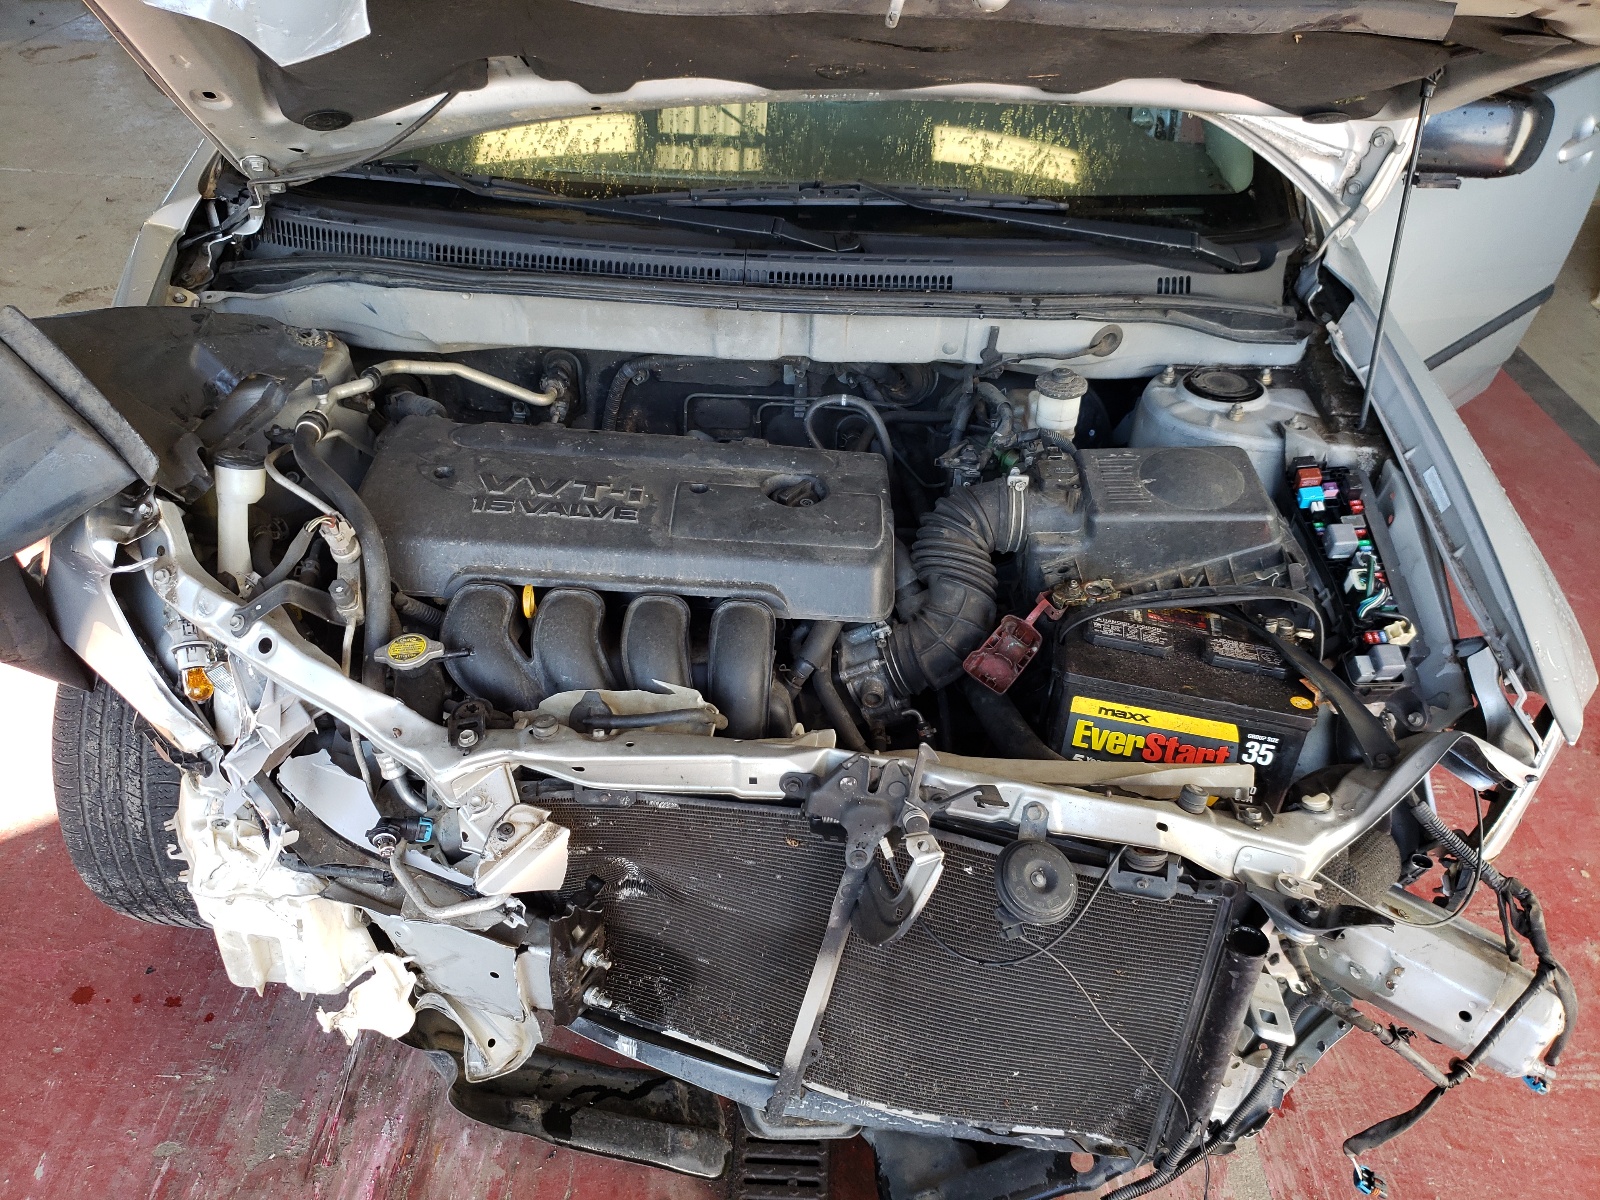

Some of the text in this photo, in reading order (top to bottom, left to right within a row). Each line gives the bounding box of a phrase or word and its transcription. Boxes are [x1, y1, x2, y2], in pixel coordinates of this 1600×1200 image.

[478, 473, 645, 506] VVT-i
[1097, 706, 1151, 723] maxx
[1071, 719, 1230, 765] EverStart
[1247, 733, 1280, 744] GROUP SIZE
[1241, 740, 1276, 766] 35
